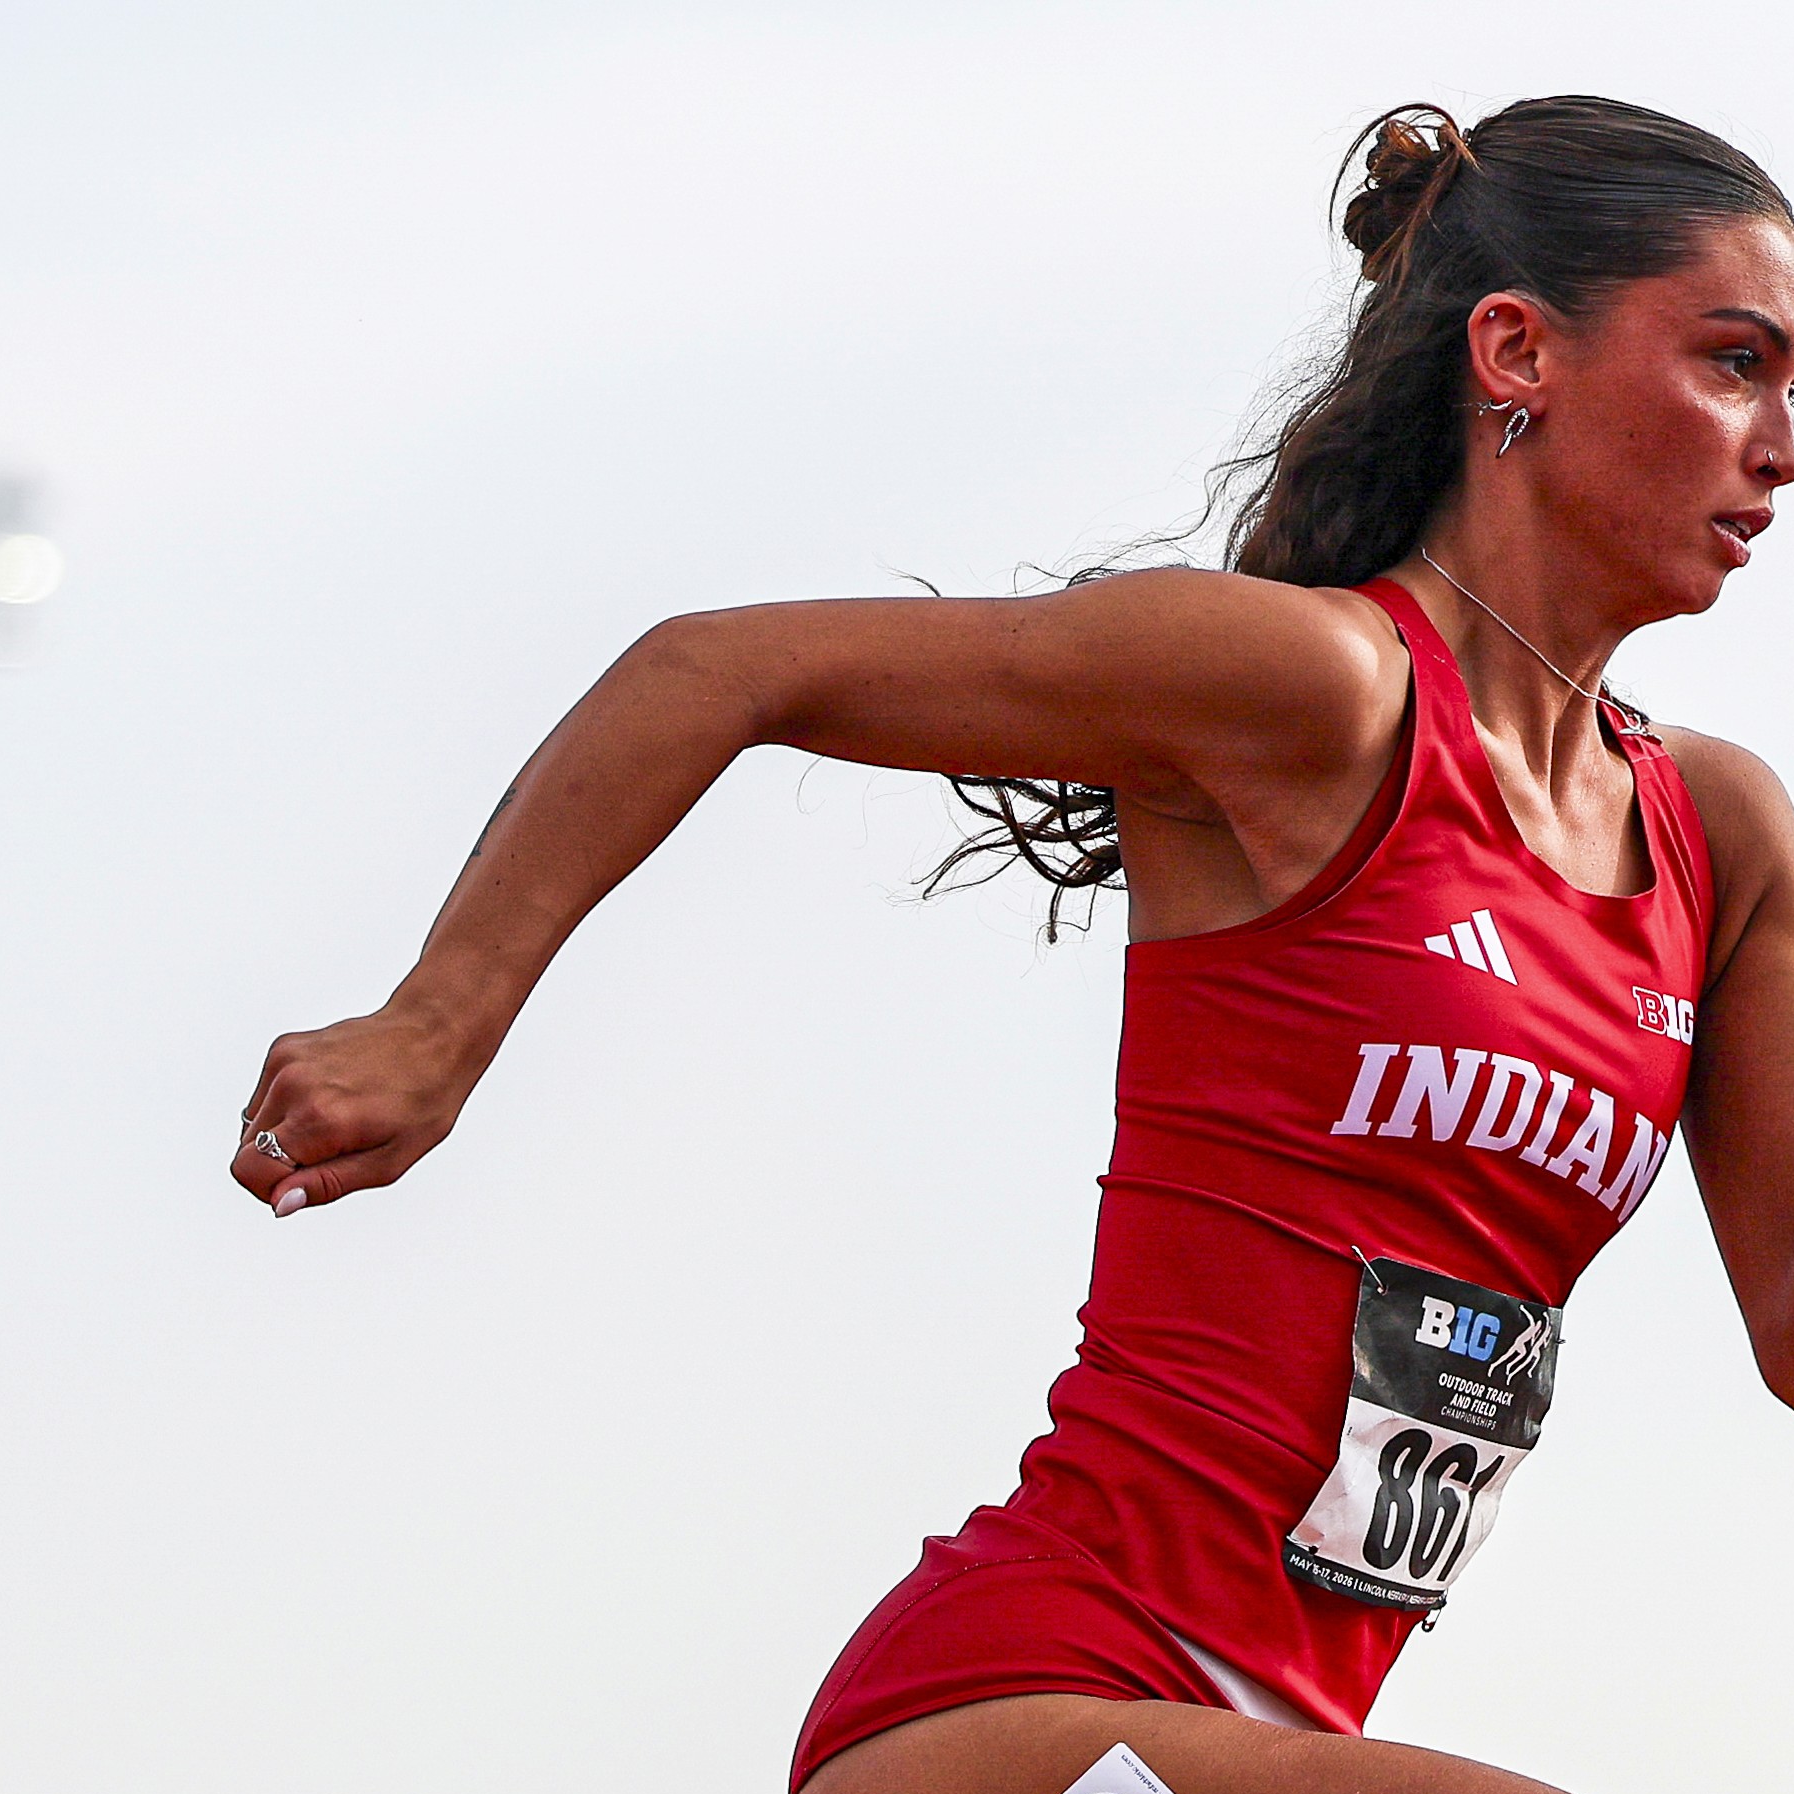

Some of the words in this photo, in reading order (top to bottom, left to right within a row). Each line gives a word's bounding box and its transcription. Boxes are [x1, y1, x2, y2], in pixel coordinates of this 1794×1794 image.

[1438, 1372, 1485, 1398] OUTDOOR
[1485, 1386, 1514, 1407] TRACK
[1441, 1405, 1497, 1431] CHAMPIONSHIPS
[1449, 1393, 1471, 1409] AND
[1470, 1398, 1497, 1417] FIELD
[1289, 1553, 1313, 1571] MAY
[1331, 1571, 1354, 1588] 2026
